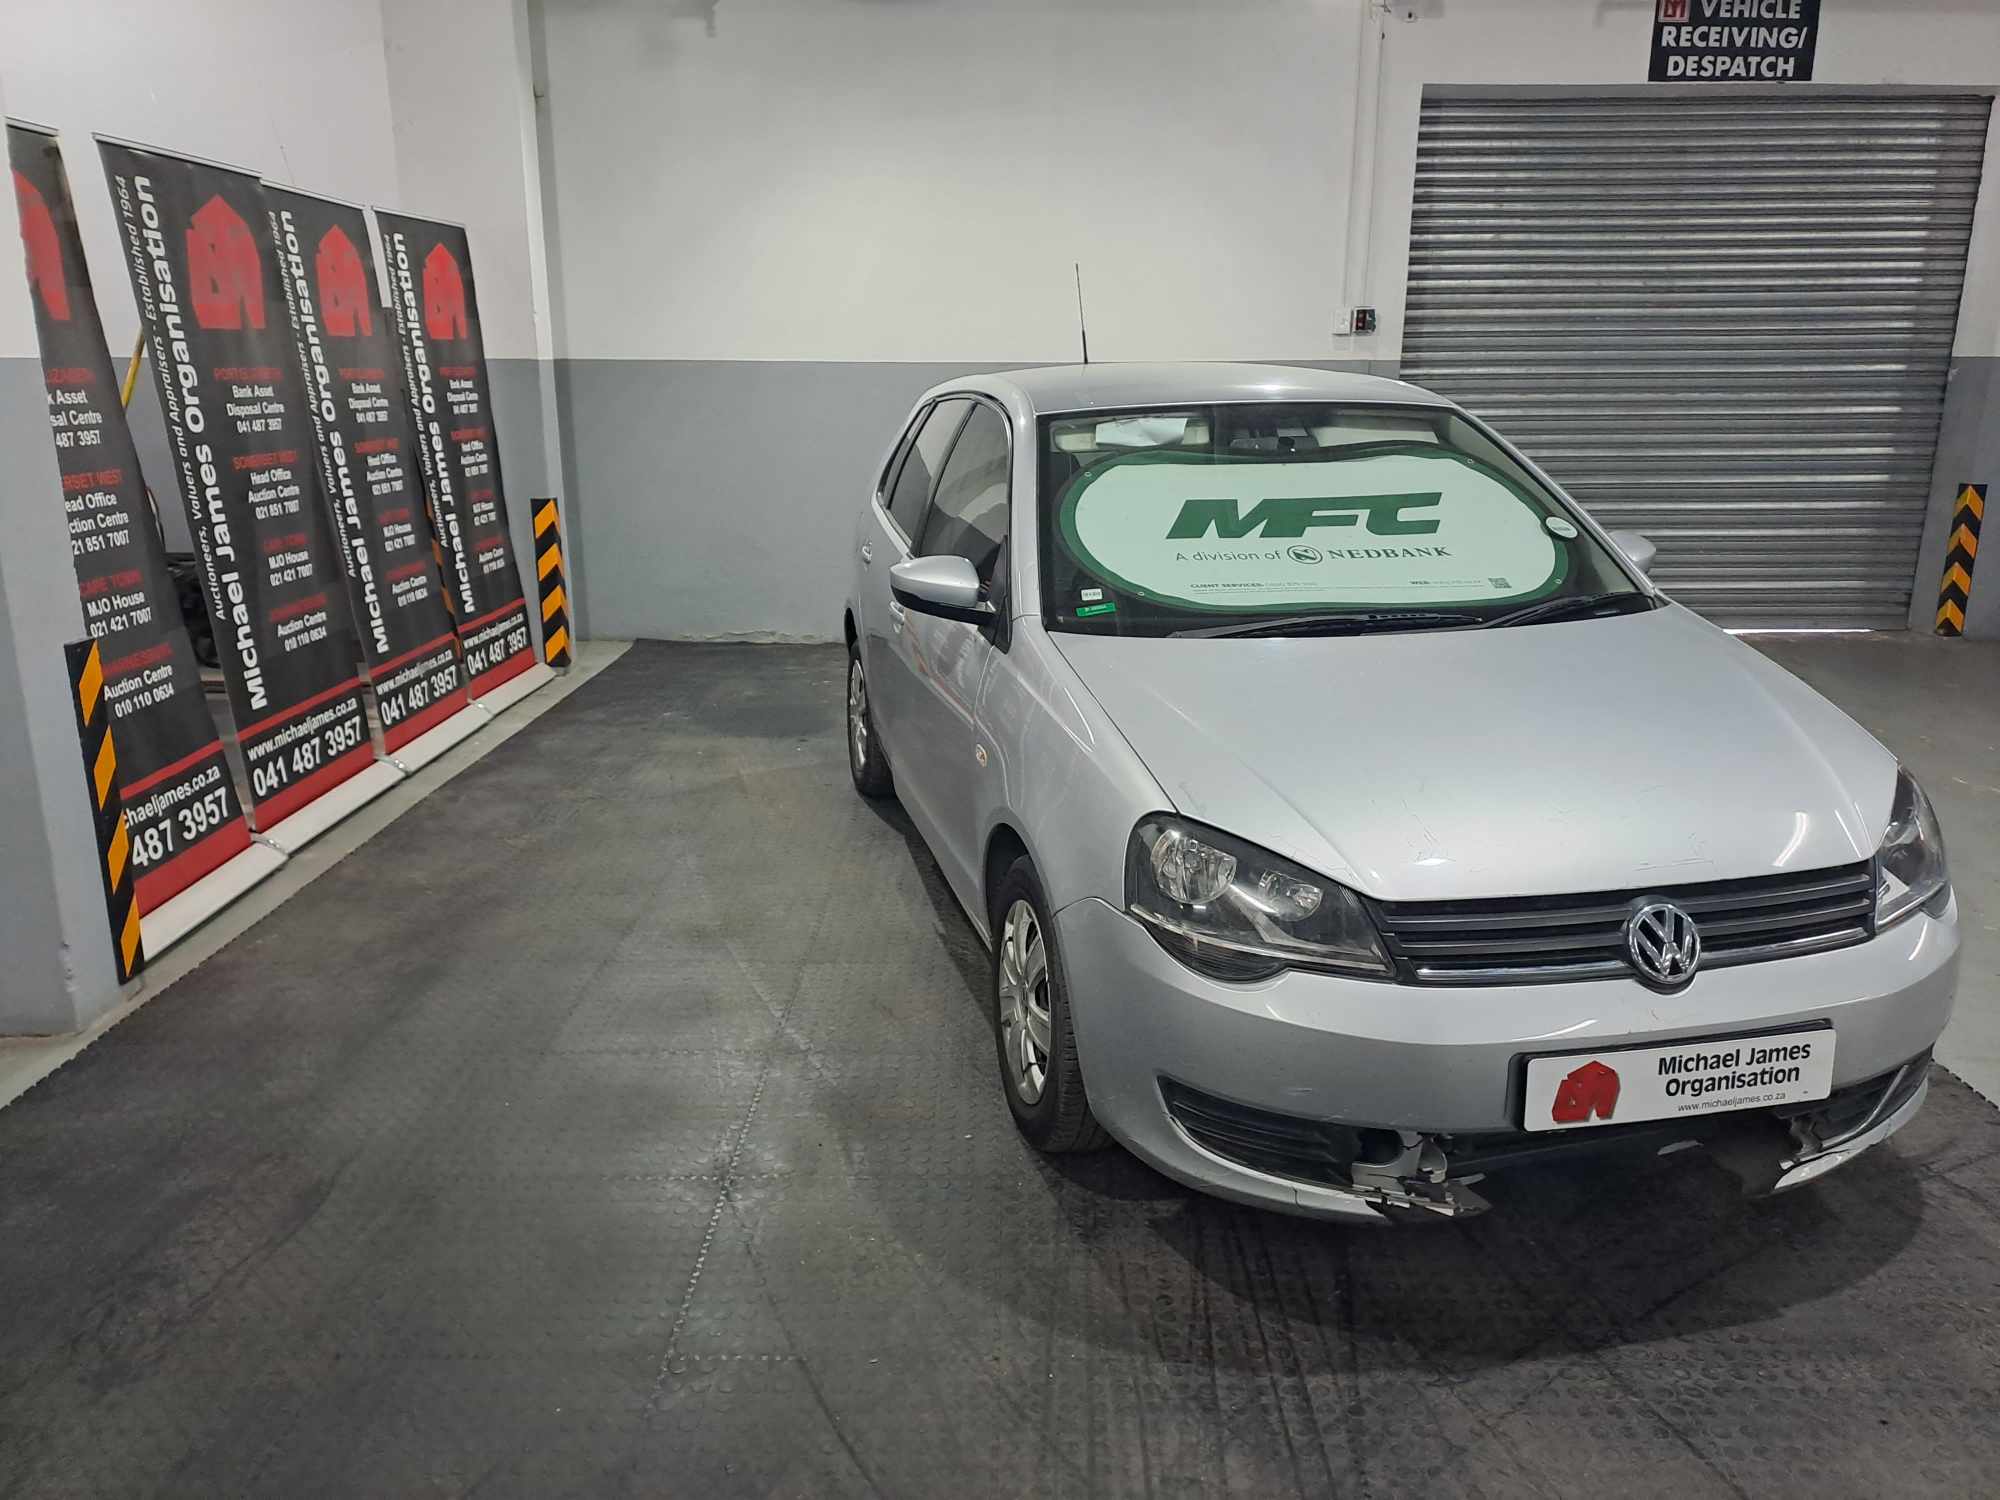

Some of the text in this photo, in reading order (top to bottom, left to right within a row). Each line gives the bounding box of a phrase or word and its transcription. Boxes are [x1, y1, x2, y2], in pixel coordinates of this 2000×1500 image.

[1702, 0, 1801, 19] VEHICLE
[1661, 26, 1808, 48] RECEIVING/
[1666, 55, 1795, 78] DESPATCH
[114, 175, 135, 221] 1964
[124, 223, 157, 321] Established
[280, 210, 337, 423] Organisation
[56, 389, 88, 405] Asset
[153, 335, 182, 424] Appraisers
[69, 409, 103, 426] Centre
[392, 232, 476, 614] Michael James Organisation
[55, 430, 101, 448] 487 3957
[134, 175, 268, 711] Michael James Organisation
[172, 424, 188, 458] and
[178, 460, 203, 521] Valuers
[329, 430, 362, 530] James
[65, 491, 118, 513] ead Office
[1165, 491, 1443, 539] MFC
[68, 510, 130, 535] ction Centre
[71, 529, 130, 557] 21 851 7007
[1175, 552, 1189, 562] A
[1192, 550, 1261, 562] division
[1264, 550, 1282, 561] of
[1327, 546, 1452, 560] NEDBANK
[198, 525, 227, 621] Auctioneers,
[86, 590, 145, 618] MJO House
[351, 536, 390, 655] Michael
[89, 606, 152, 639] 021 421 7007
[466, 626, 528, 676] 041 487 3957
[103, 662, 174, 702] Auction Centre
[114, 681, 175, 719] 010 110 0634
[380, 664, 459, 726] 041 487 3957
[247, 697, 358, 762] www.michaeljames.co.za
[253, 715, 363, 798] 041 487 3957
[123, 764, 221, 830] haeljames.co.za
[131, 786, 230, 868] 487 3957
[1658, 1043, 1811, 1076] Michael James
[1665, 1066, 1800, 1097] Organisation
[1677, 1091, 1786, 1112] www.michaeljames.co.za
